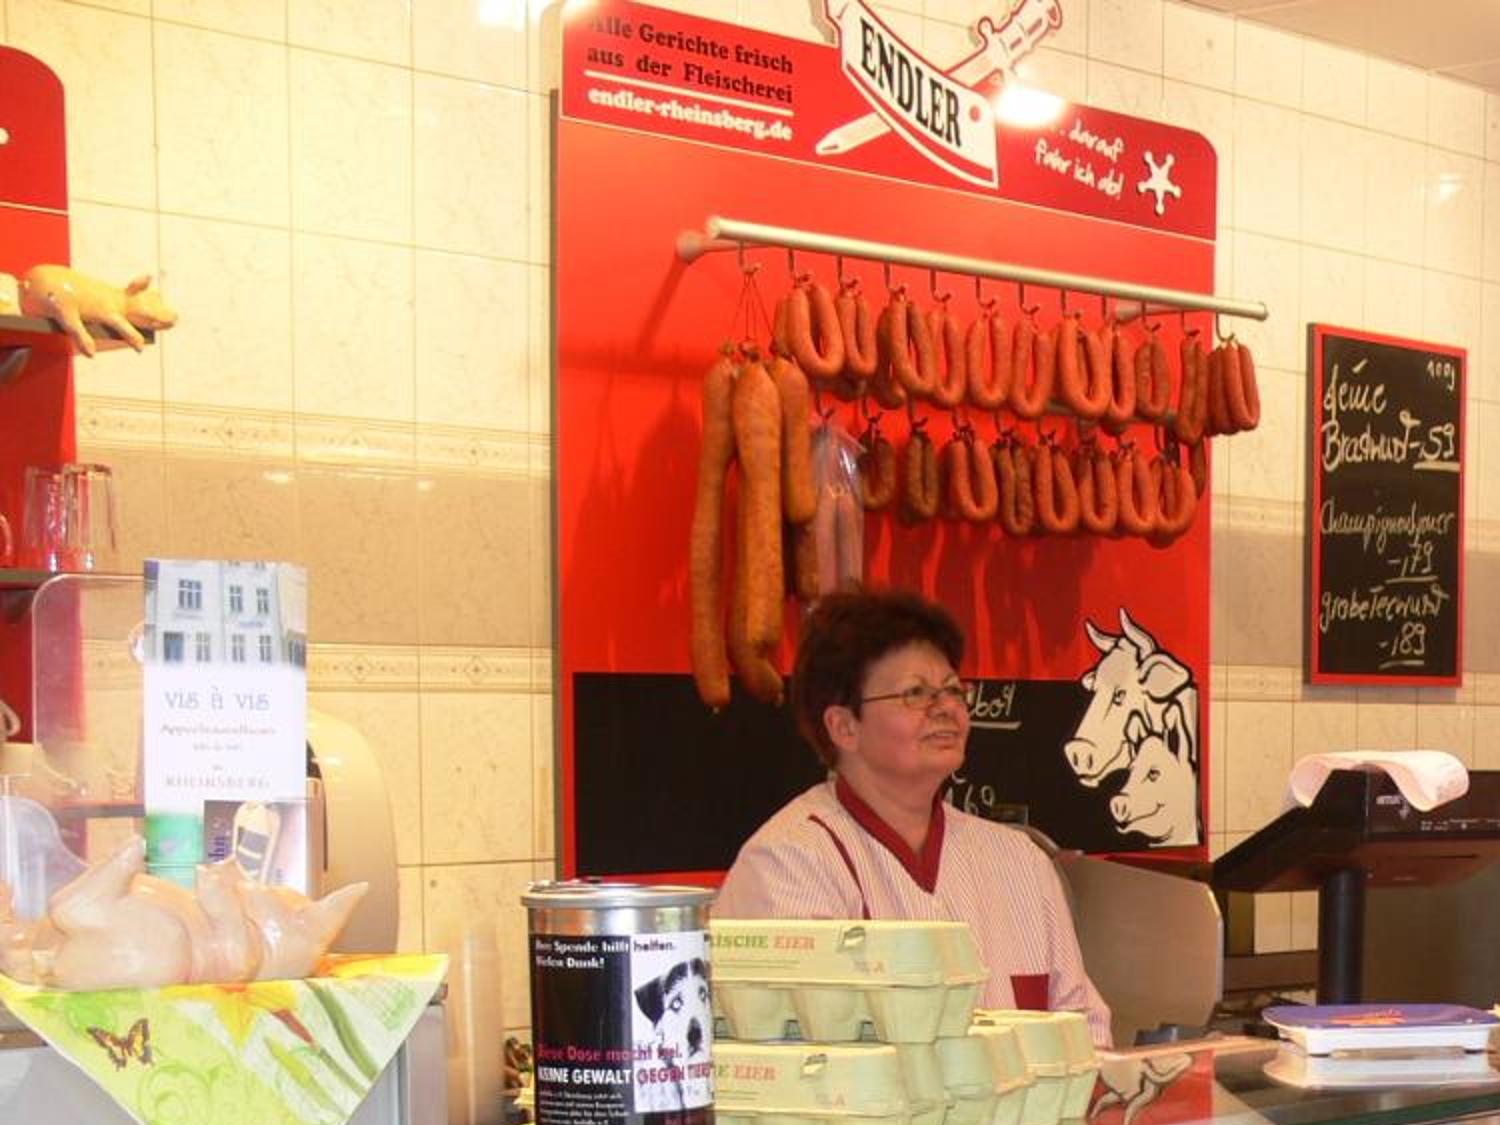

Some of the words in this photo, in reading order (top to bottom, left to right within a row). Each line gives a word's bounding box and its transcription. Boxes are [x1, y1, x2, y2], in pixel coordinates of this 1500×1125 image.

[639, 24, 730, 59] Gerichte
[735, 44, 793, 74] frisch
[587, 47, 624, 68] aus
[636, 54, 673, 77] der
[683, 62, 793, 103] Fleischerei
[859, 16, 963, 148] ENDLER
[587, 88, 794, 141] endler-rheinsberg.de
[773, 935, 815, 950] EIER
[537, 1066, 570, 1083] KEINE
[572, 1068, 632, 1085] GEWALT
